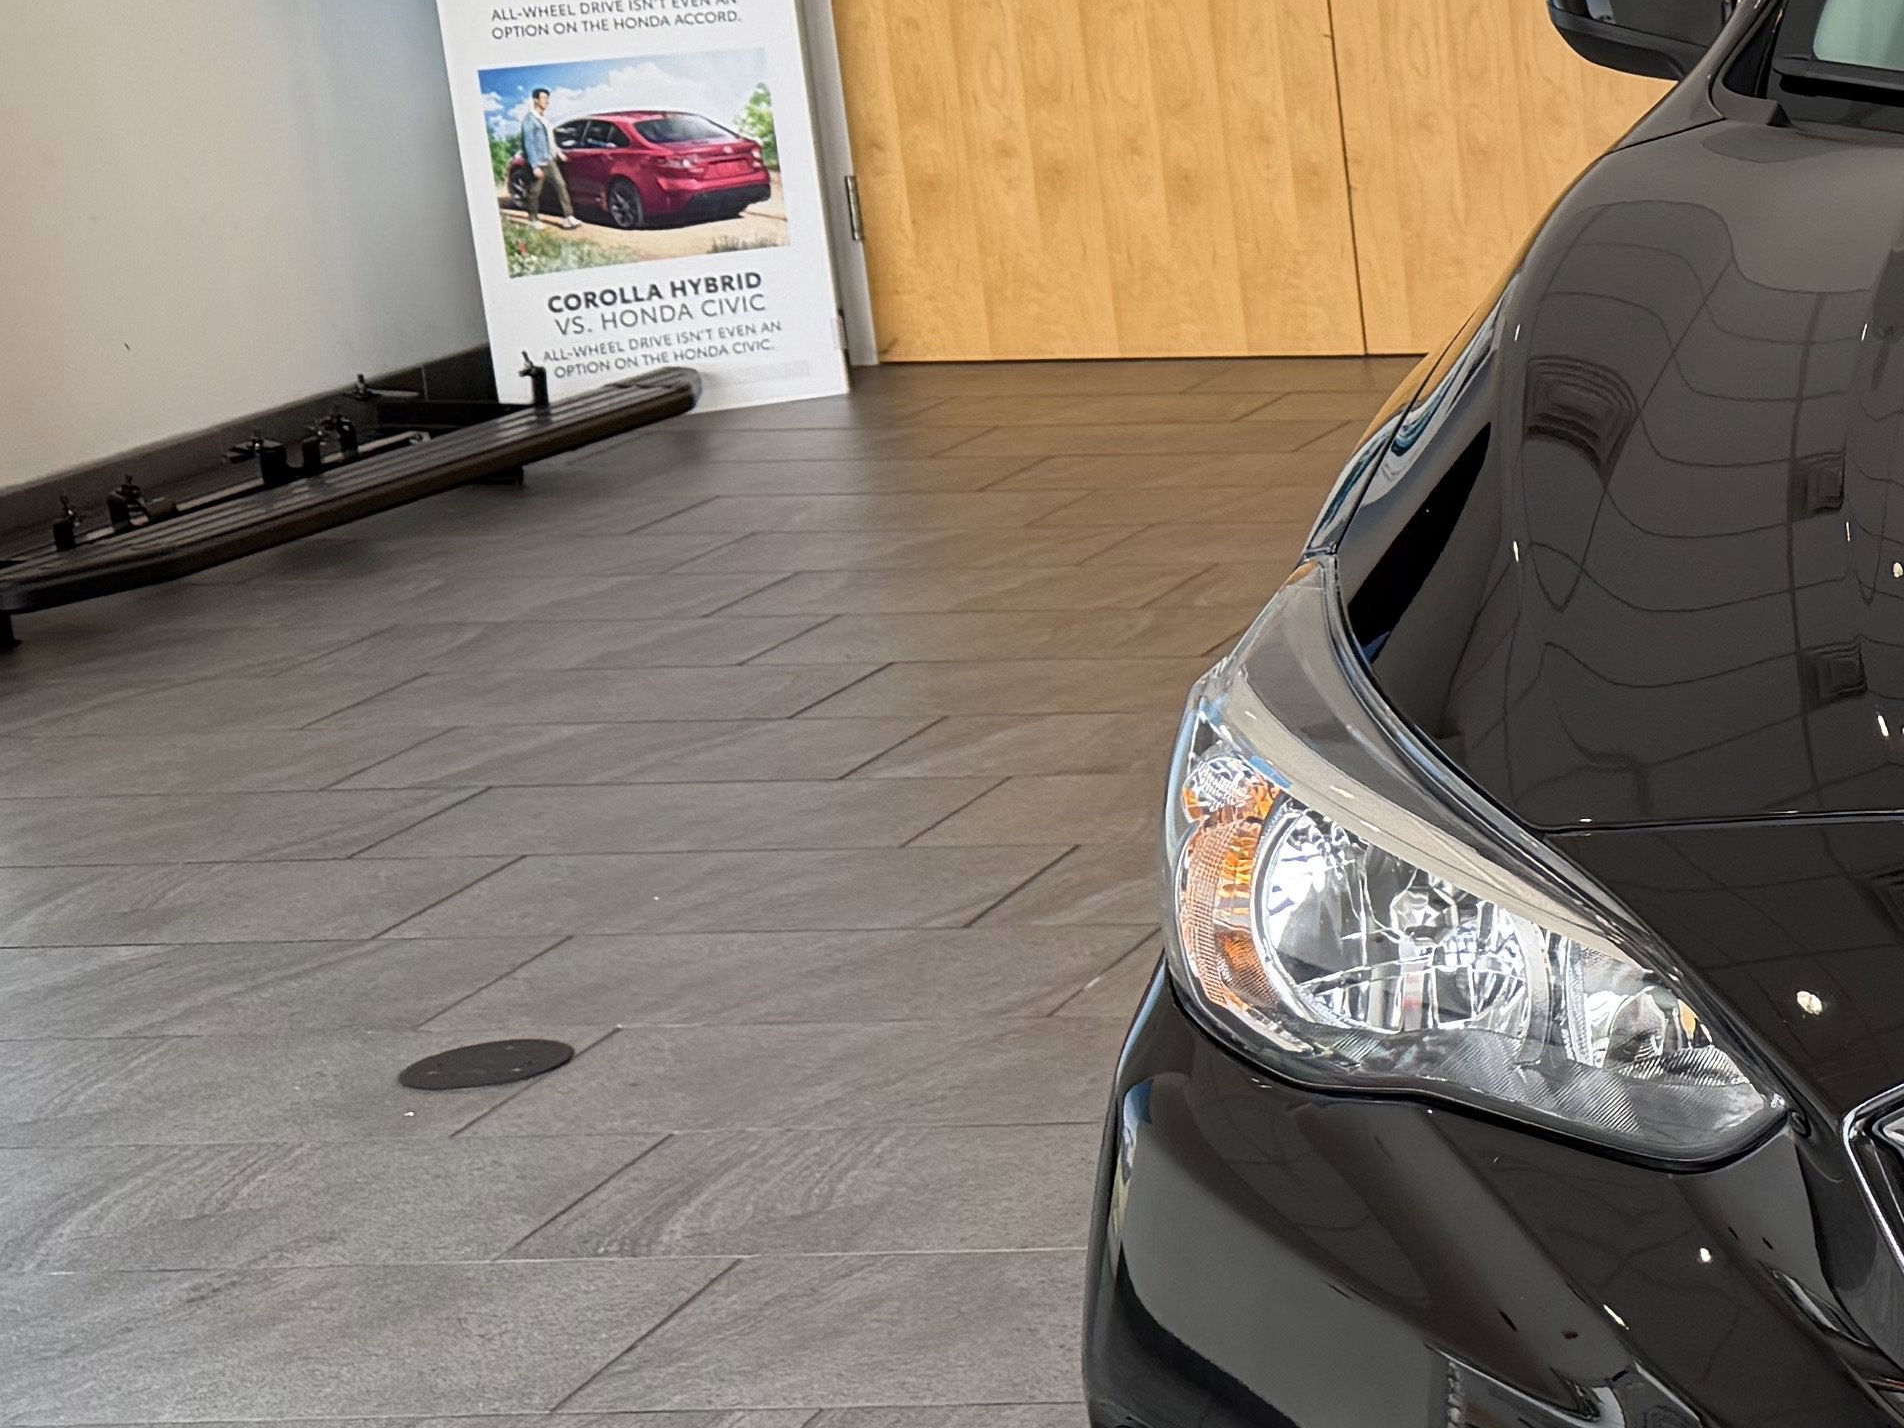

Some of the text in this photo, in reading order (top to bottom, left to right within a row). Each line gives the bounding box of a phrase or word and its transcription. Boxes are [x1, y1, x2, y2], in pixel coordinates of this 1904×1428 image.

[491, 5, 575, 21] ALL-WHEEL
[580, 0, 623, 15] DRIVE
[491, 11, 742, 40] OPTION ON THE HONDA ACCORD.
[547, 271, 762, 313] COROLLA HYBRID
[555, 293, 766, 336] VS. HONDA CIVIC
[543, 320, 781, 362] ALL-WHEEL DRIVE ISN'T EVEN AN
[554, 361, 611, 379] OPTION
[615, 356, 639, 370] ON
[642, 352, 670, 368] THE
[672, 347, 728, 364] HONDA
